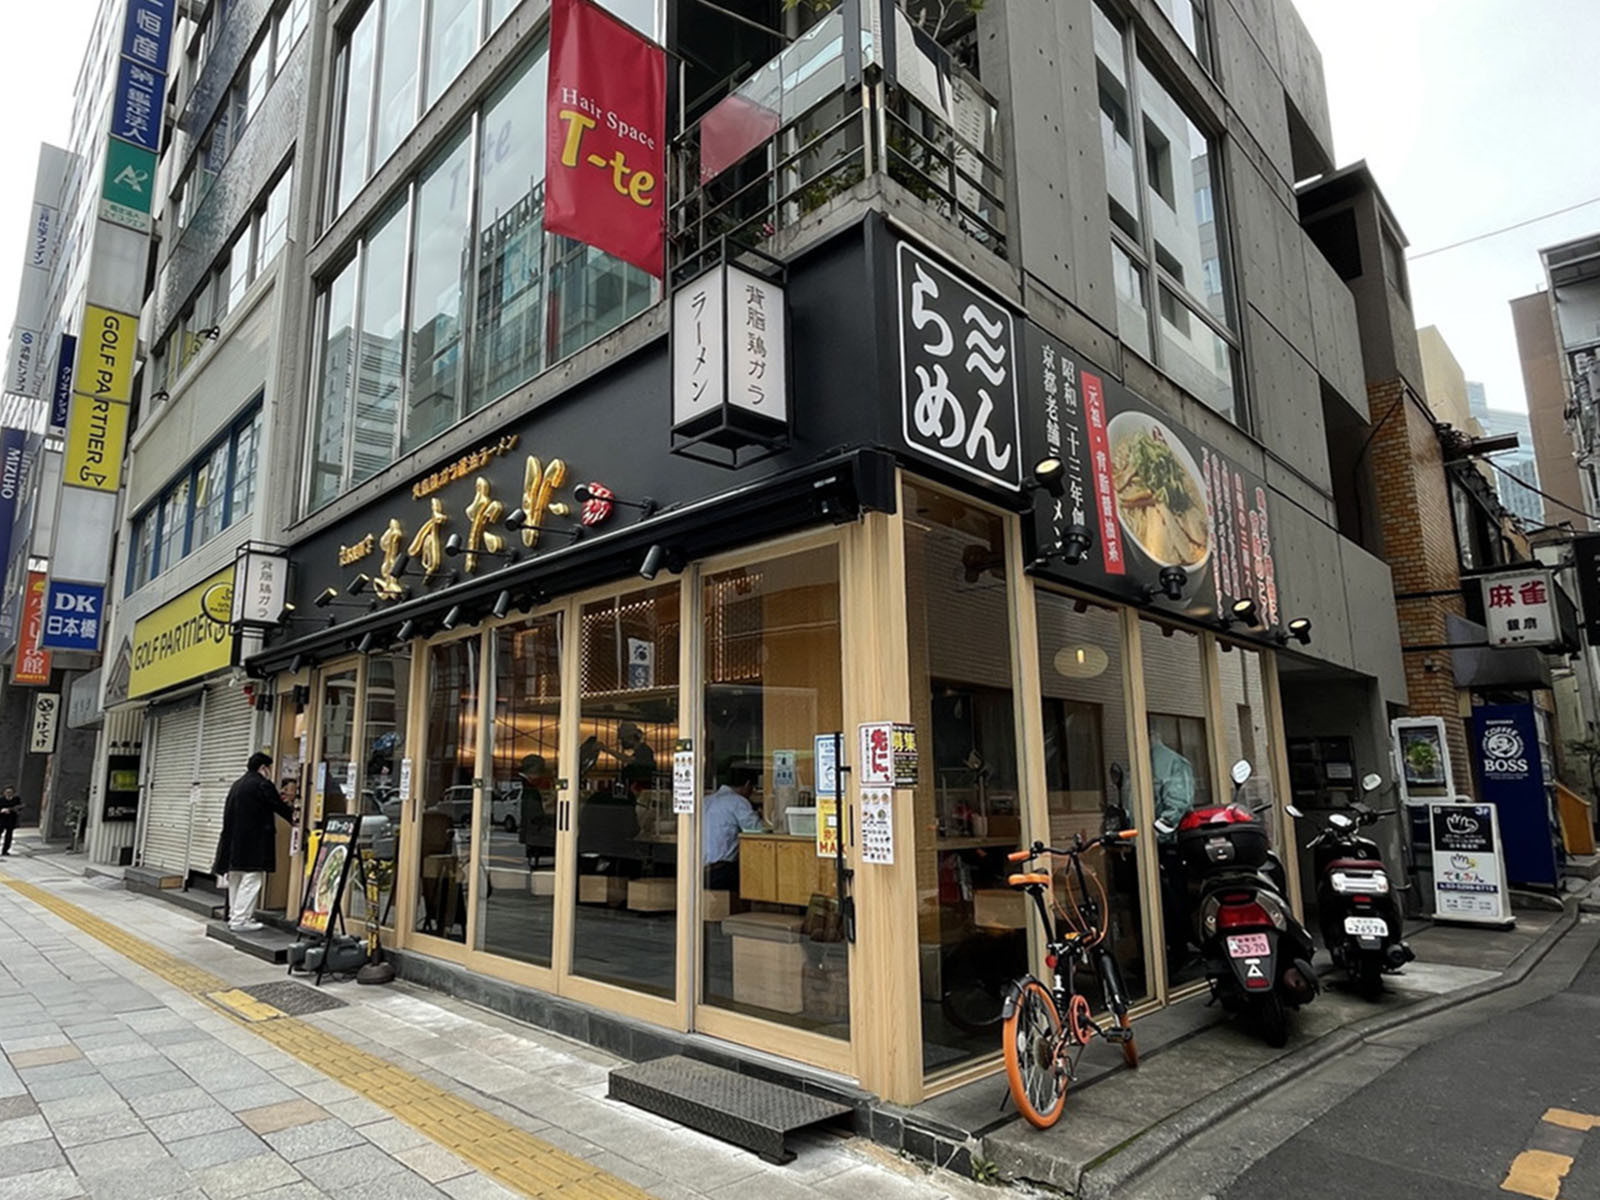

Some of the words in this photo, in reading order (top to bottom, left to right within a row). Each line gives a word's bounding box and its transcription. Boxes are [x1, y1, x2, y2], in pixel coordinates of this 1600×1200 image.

[132, 0, 164, 63] 恒産
[561, 86, 602, 119] Hair
[606, 112, 655, 150] Space
[559, 108, 656, 207] T-te
[98, 315, 120, 366] GOLF
[691, 290, 709, 402] ラーメン
[745, 284, 767, 406] 背脂鶏ガラ
[1, 448, 21, 500] MIZUHO
[1061, 357, 1088, 560] 昭和二十三年創
[54, 592, 97, 612] DK
[1489, 580, 1548, 608] 麻雀
[47, 617, 99, 639] 日本橋
[135, 632, 160, 672] GOLF
[1483, 758, 1528, 772] BOSS
